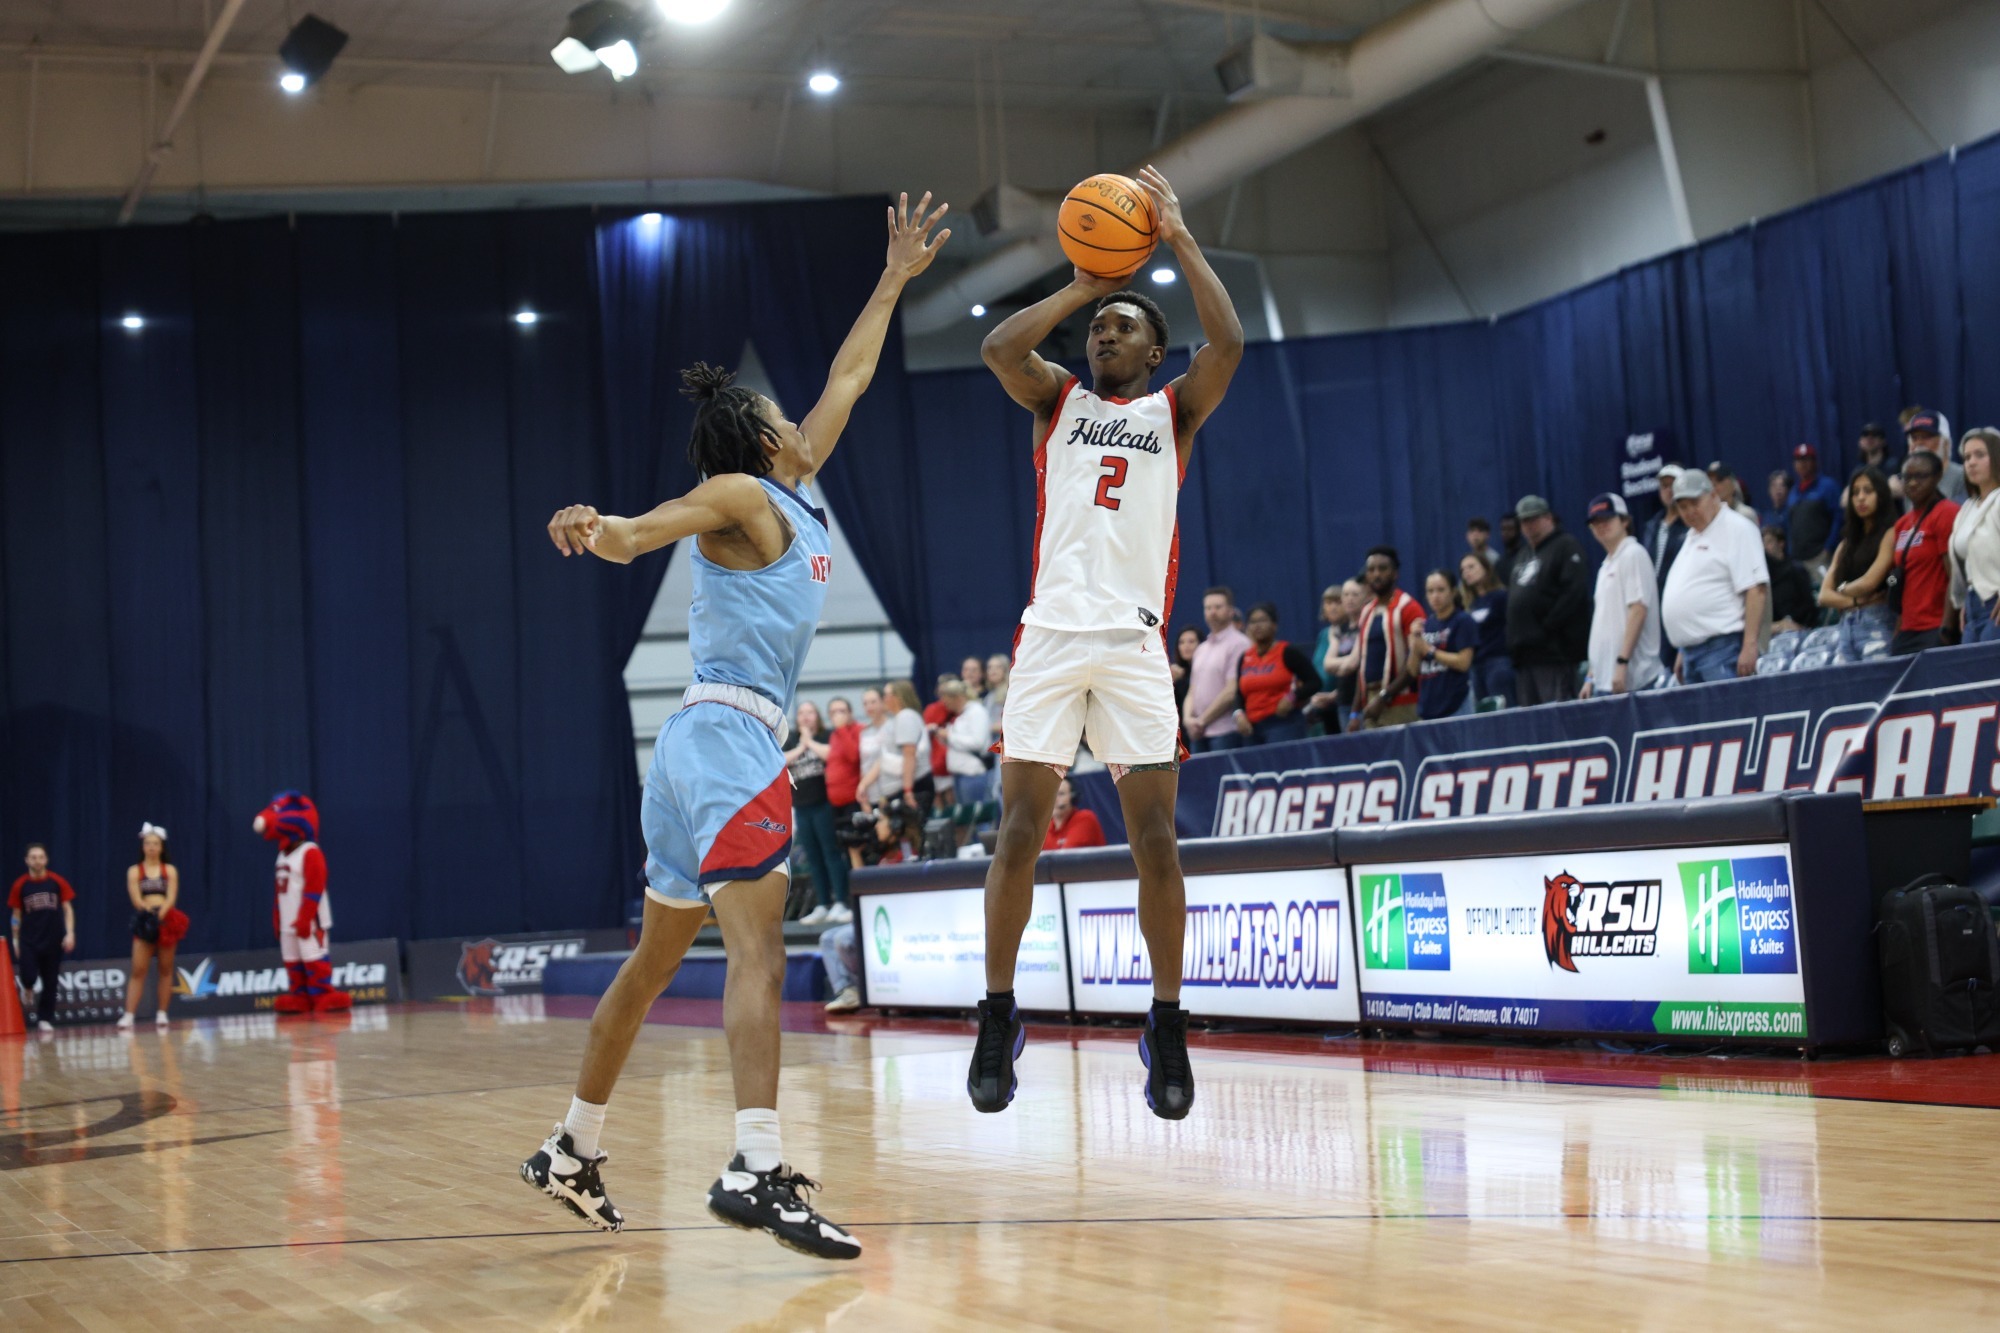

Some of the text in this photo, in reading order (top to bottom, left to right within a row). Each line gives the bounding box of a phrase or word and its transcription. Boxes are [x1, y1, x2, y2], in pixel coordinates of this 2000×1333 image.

[1067, 418, 1161, 454] Hillcats
[1094, 455, 1128, 511] 2
[810, 554, 831, 584] NE
[1218, 701, 2000, 837] ROGERS STATE HILLCAT
[1405, 892, 1446, 912] Holiday Inn
[1738, 878, 1789, 903] Holiday Inn
[1466, 907, 1536, 935] OFFICIAL HOTEL OF
[1576, 884, 1660, 933] RSU
[1741, 905, 1789, 936] Express
[1407, 913, 1447, 939] Express
[1079, 900, 1340, 990] WWW.HILLCATS.COM
[1413, 941, 1442, 955] & Suites
[1571, 934, 1656, 955] HILLCATS
[1750, 938, 1785, 955] & Suites
[216, 962, 386, 996] MidArica
[1366, 1000, 1385, 1017] 1410
[1385, 1001, 1413, 1021] Country
[1414, 1002, 1431, 1021] Club
[1433, 1003, 1451, 1021] Road
[1457, 1004, 1499, 1025] Claremore,
[1500, 1006, 1512, 1024] OK
[1514, 1007, 1540, 1025] 74017
[1671, 1006, 1802, 1037] www.hiexpress.com
